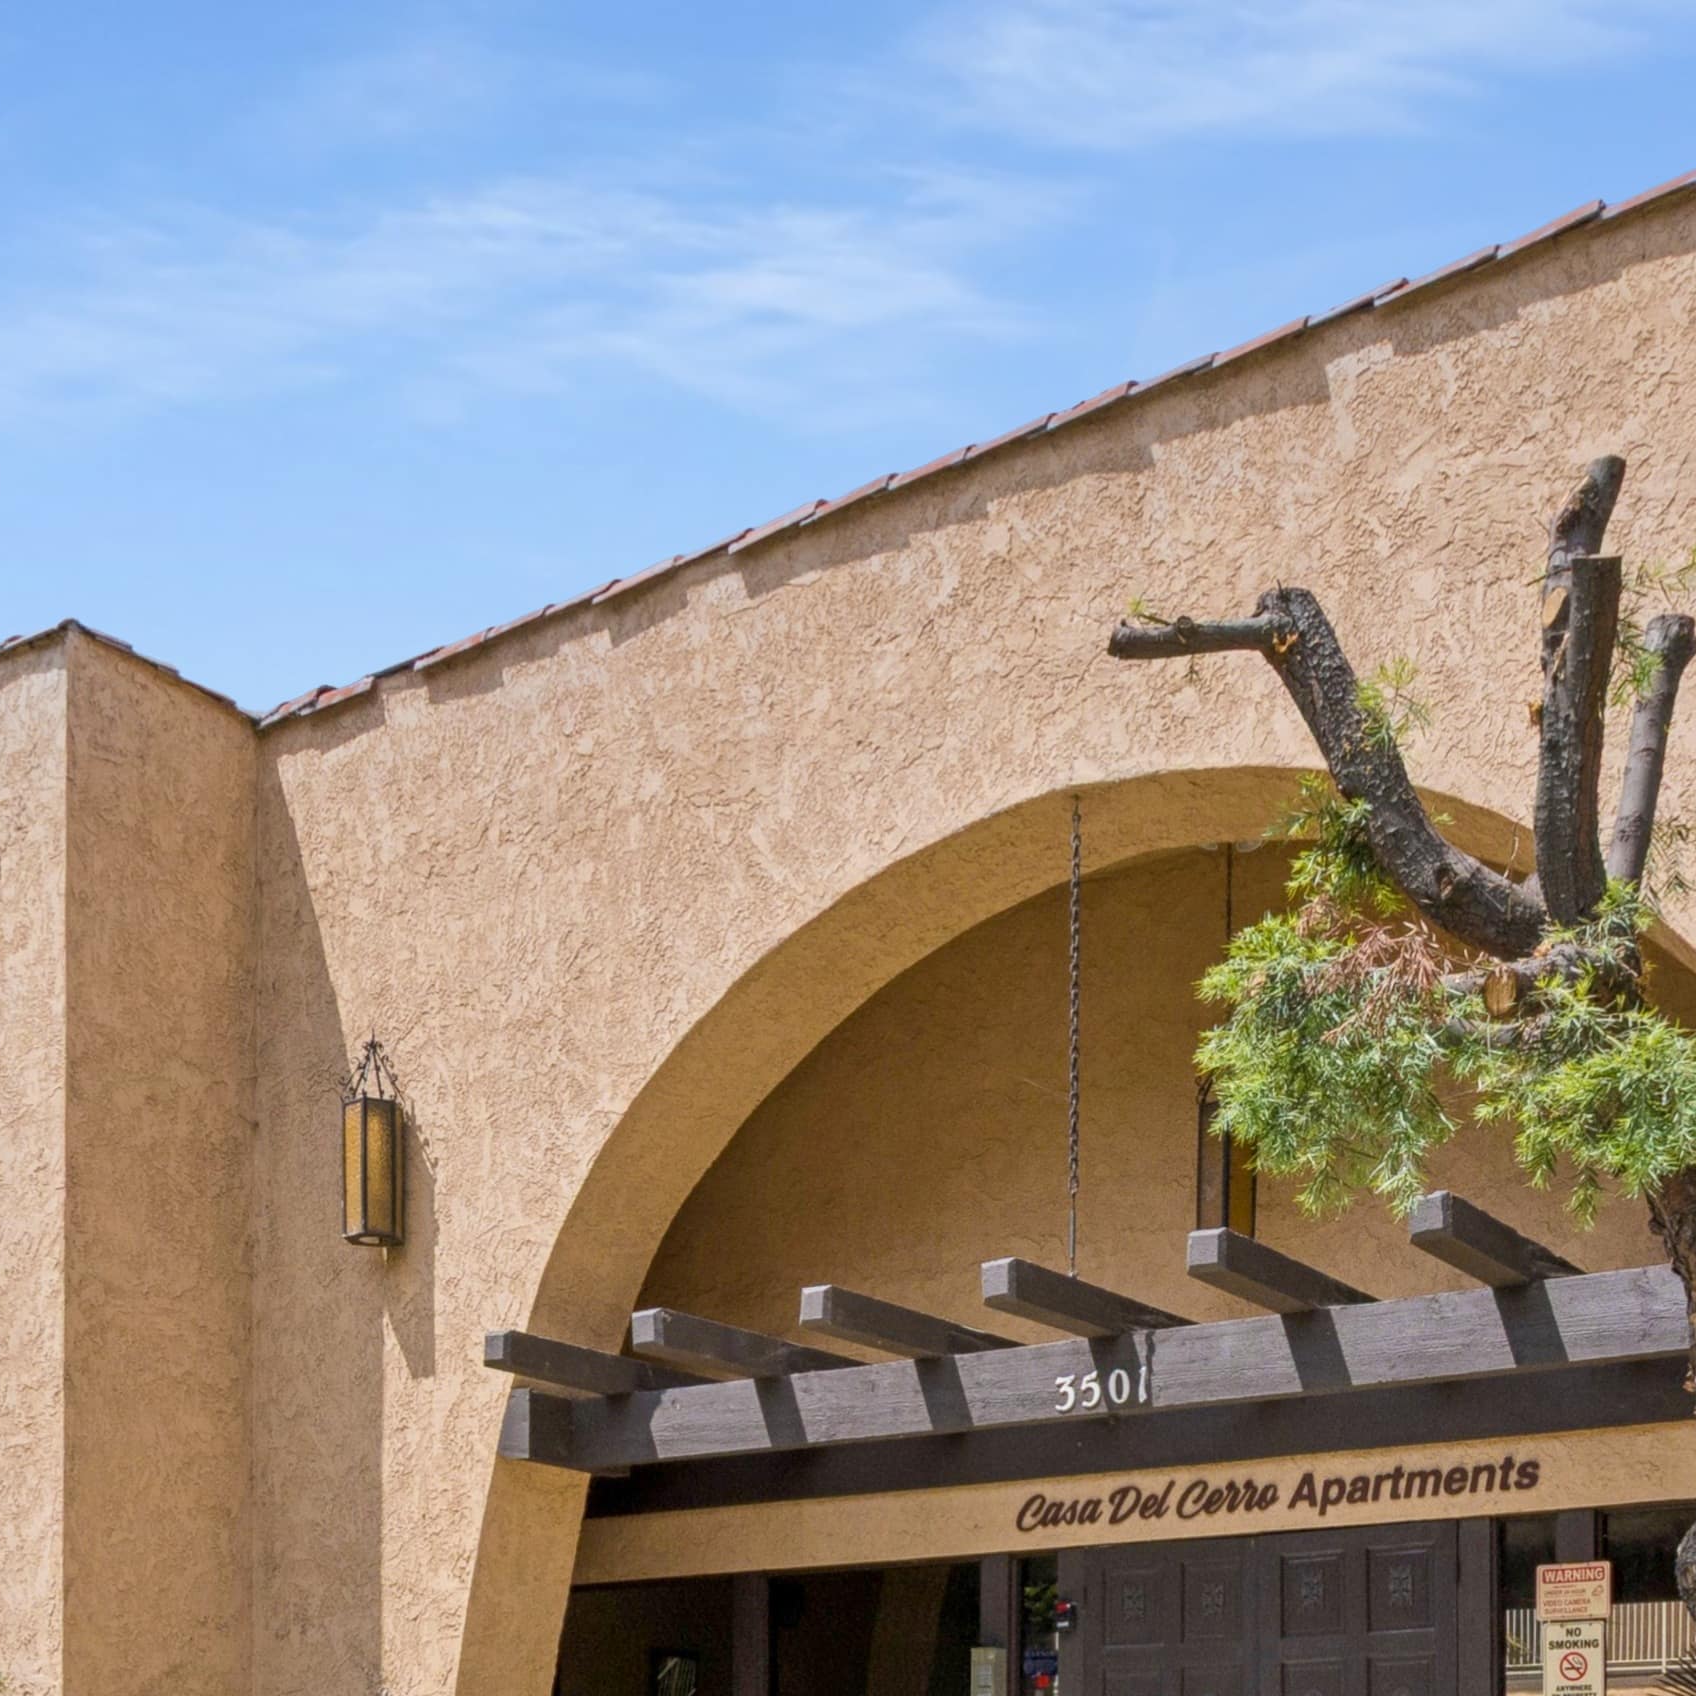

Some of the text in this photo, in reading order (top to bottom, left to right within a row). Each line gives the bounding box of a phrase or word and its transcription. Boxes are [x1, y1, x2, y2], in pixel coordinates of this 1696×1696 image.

[1054, 1366, 1148, 1412] 3501
[1016, 1455, 1541, 1532] Casa Del Cerro Apartments
[1544, 1567, 1604, 1583] WARNING
[1565, 1627, 1582, 1637] NO
[1548, 1638, 1600, 1650] SMOKING
[1556, 1684, 1593, 1692] ANYWHERE
